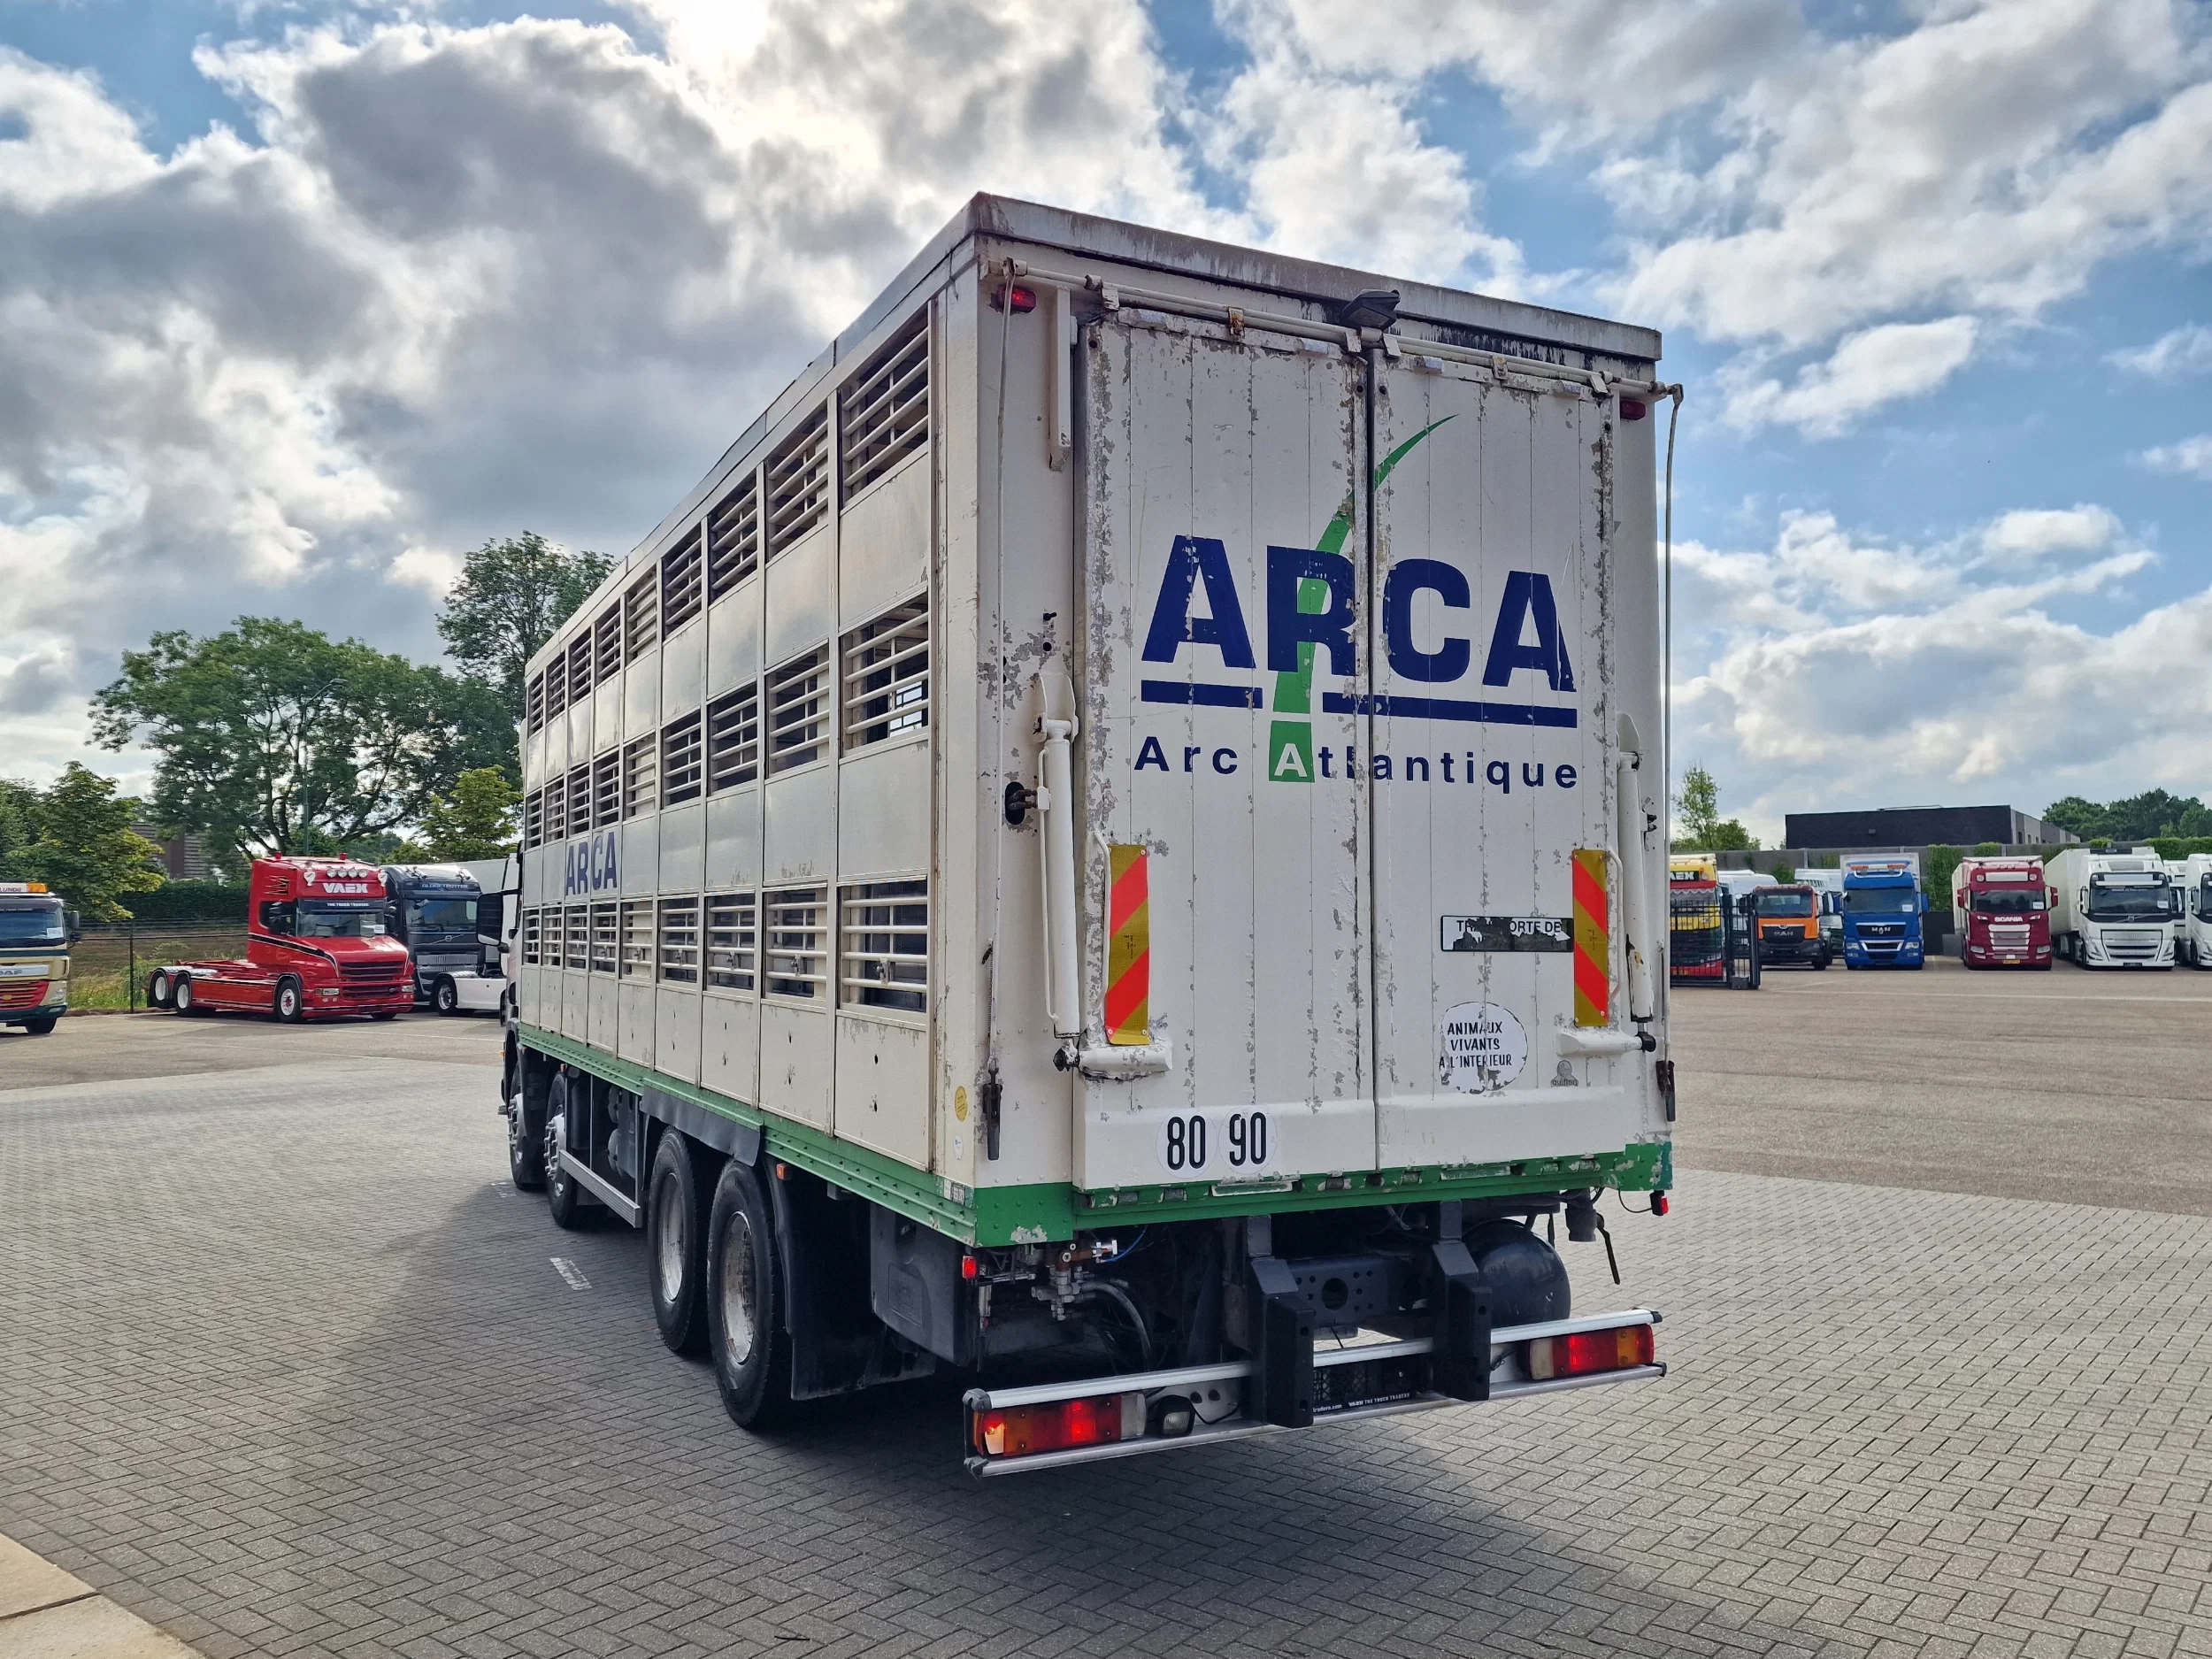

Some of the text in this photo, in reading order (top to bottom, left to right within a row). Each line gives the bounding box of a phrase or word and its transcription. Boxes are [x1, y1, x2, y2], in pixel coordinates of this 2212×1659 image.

[1141, 534, 1578, 693] ARCA
[1134, 736, 1578, 795] Arc Atlantique
[323, 882, 369, 894] VAEX
[566, 832, 618, 895] ARCA
[1447, 1021, 1503, 1036] ANIMAUX
[1450, 1038, 1501, 1051] VIVANTS
[1167, 1115, 1206, 1171] 80
[1229, 1111, 1267, 1167] 90
